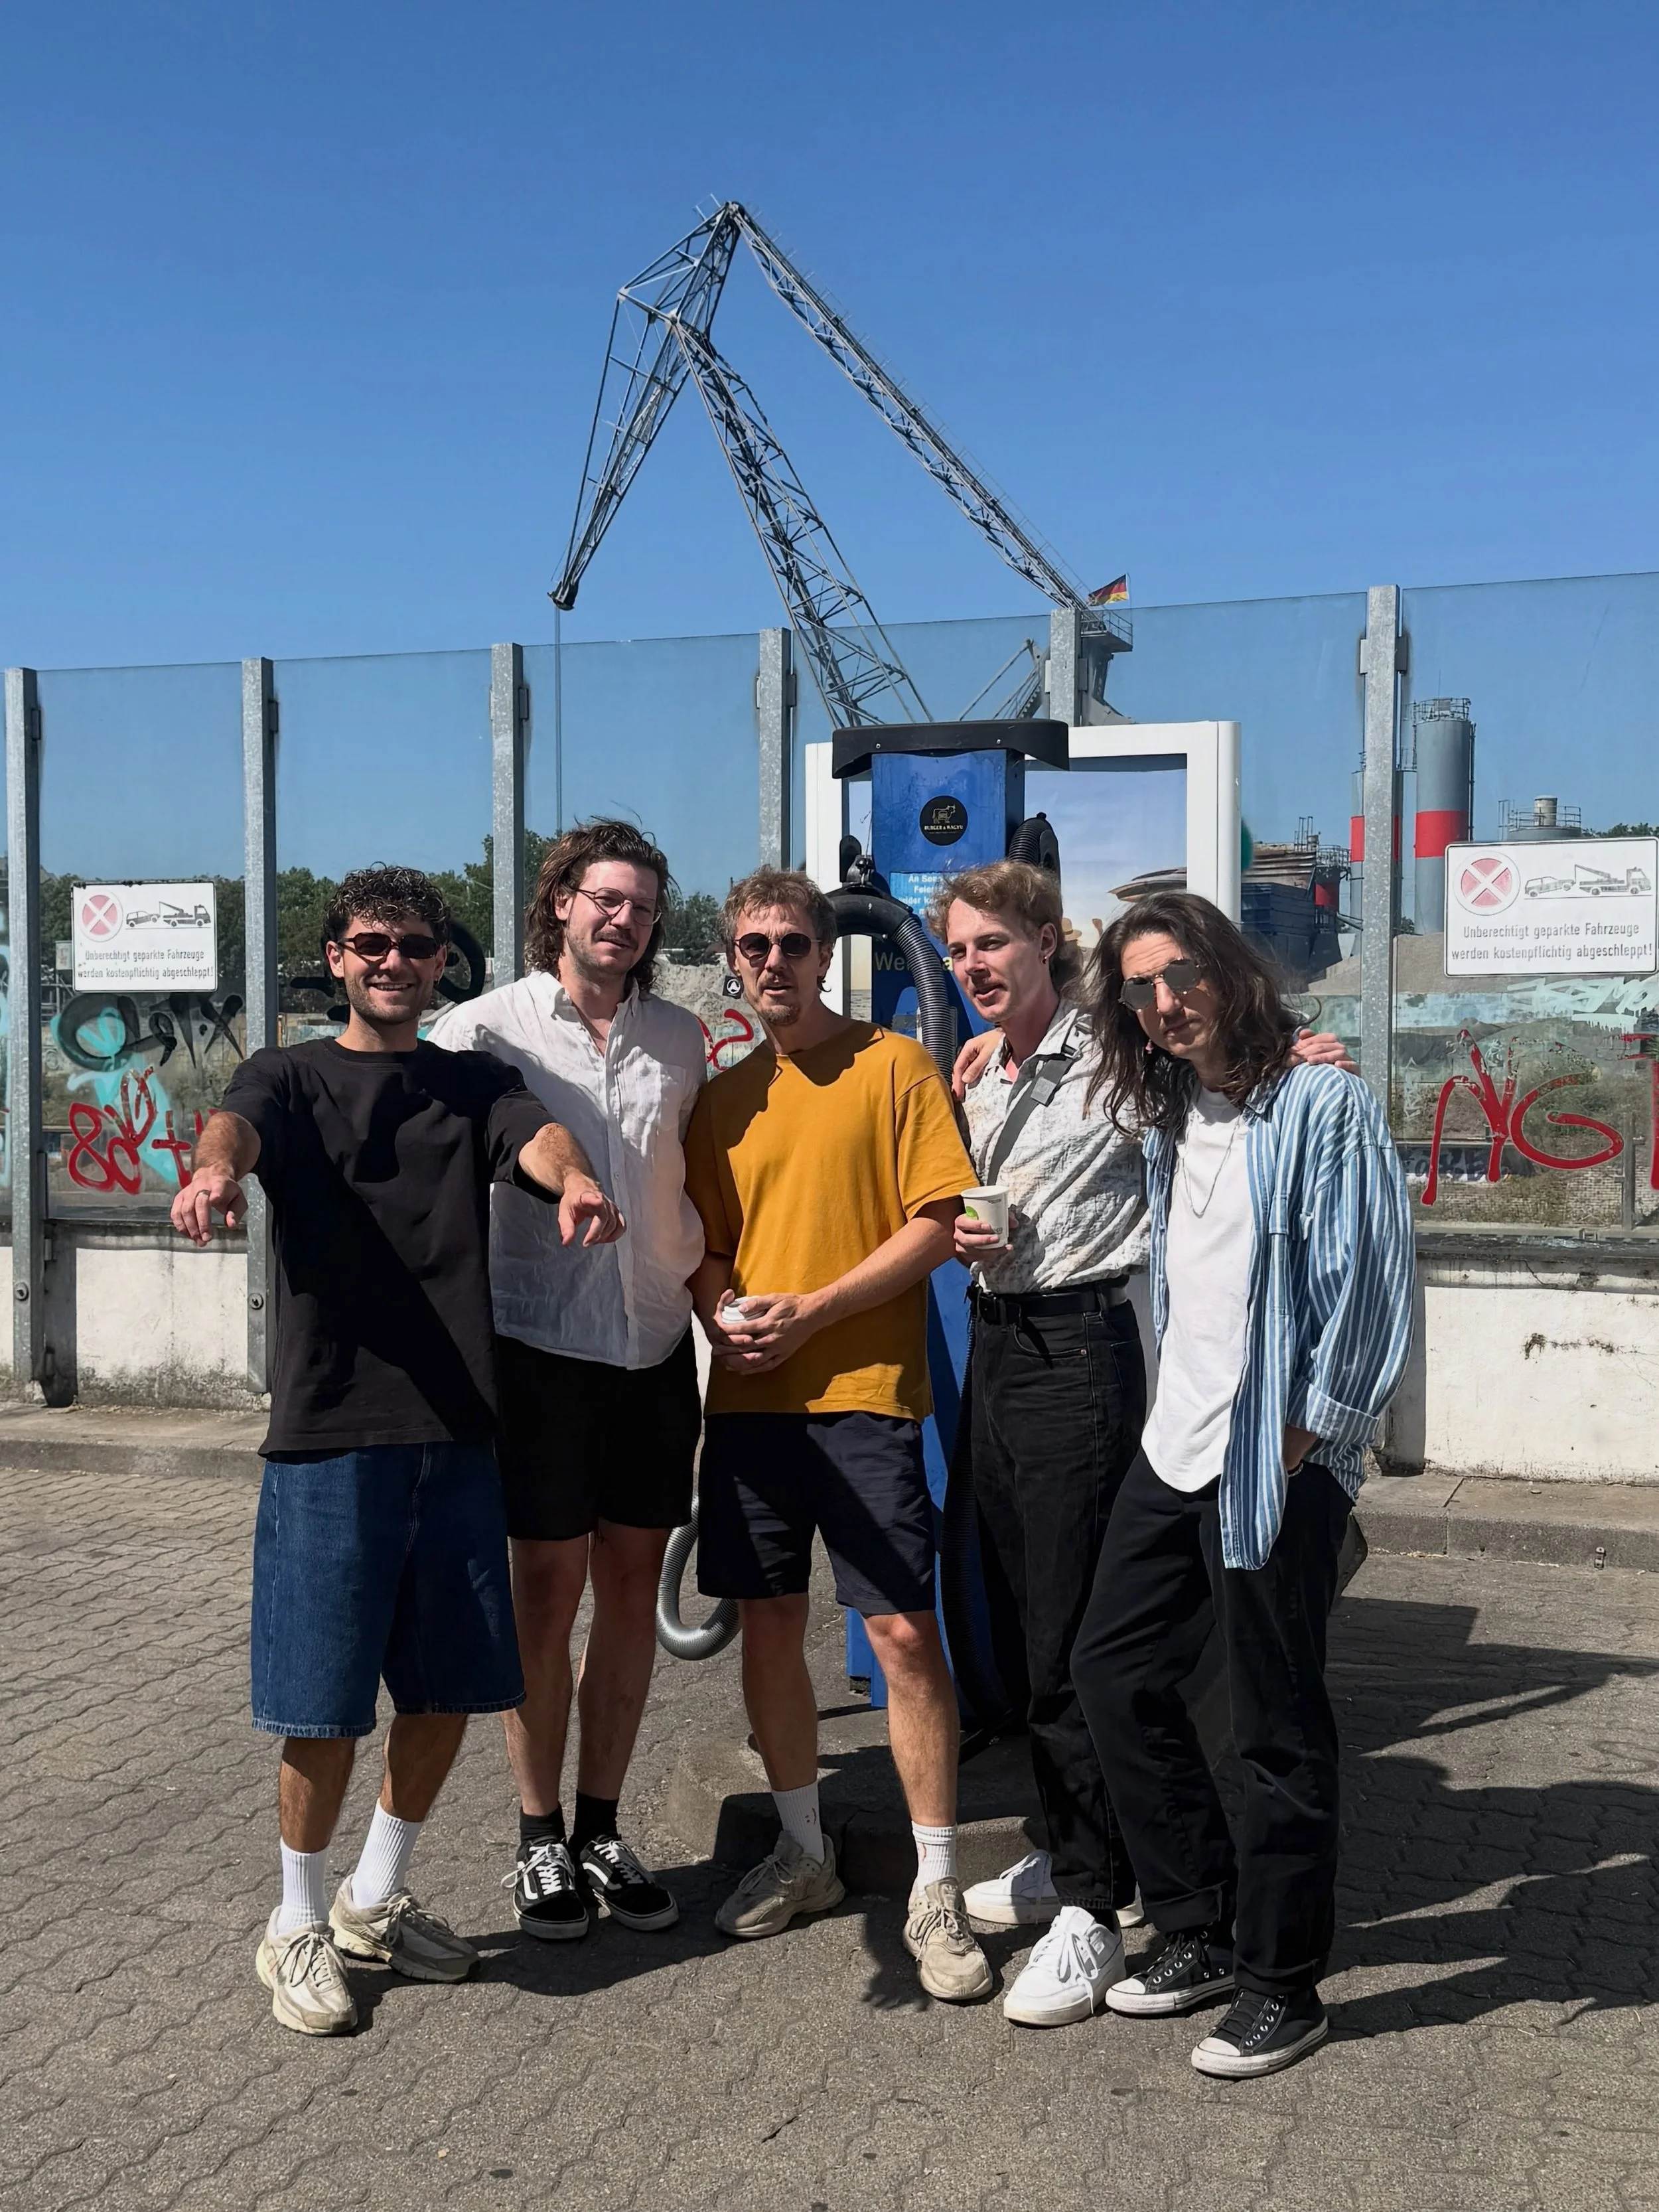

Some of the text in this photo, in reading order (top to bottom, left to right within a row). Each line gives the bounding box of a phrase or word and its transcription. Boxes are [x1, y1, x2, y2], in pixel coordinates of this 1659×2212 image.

[1463, 922, 1640, 940] Unberechtigt geparkte Fahrzeuge
[85, 948, 204, 962] Unberechtigt geparkte Fahrzeuge
[1451, 943, 1653, 962] werden kostenpflichtig abgeschleppt!
[78, 966, 214, 980] werden kostenpflichtig abgeschleppt!
